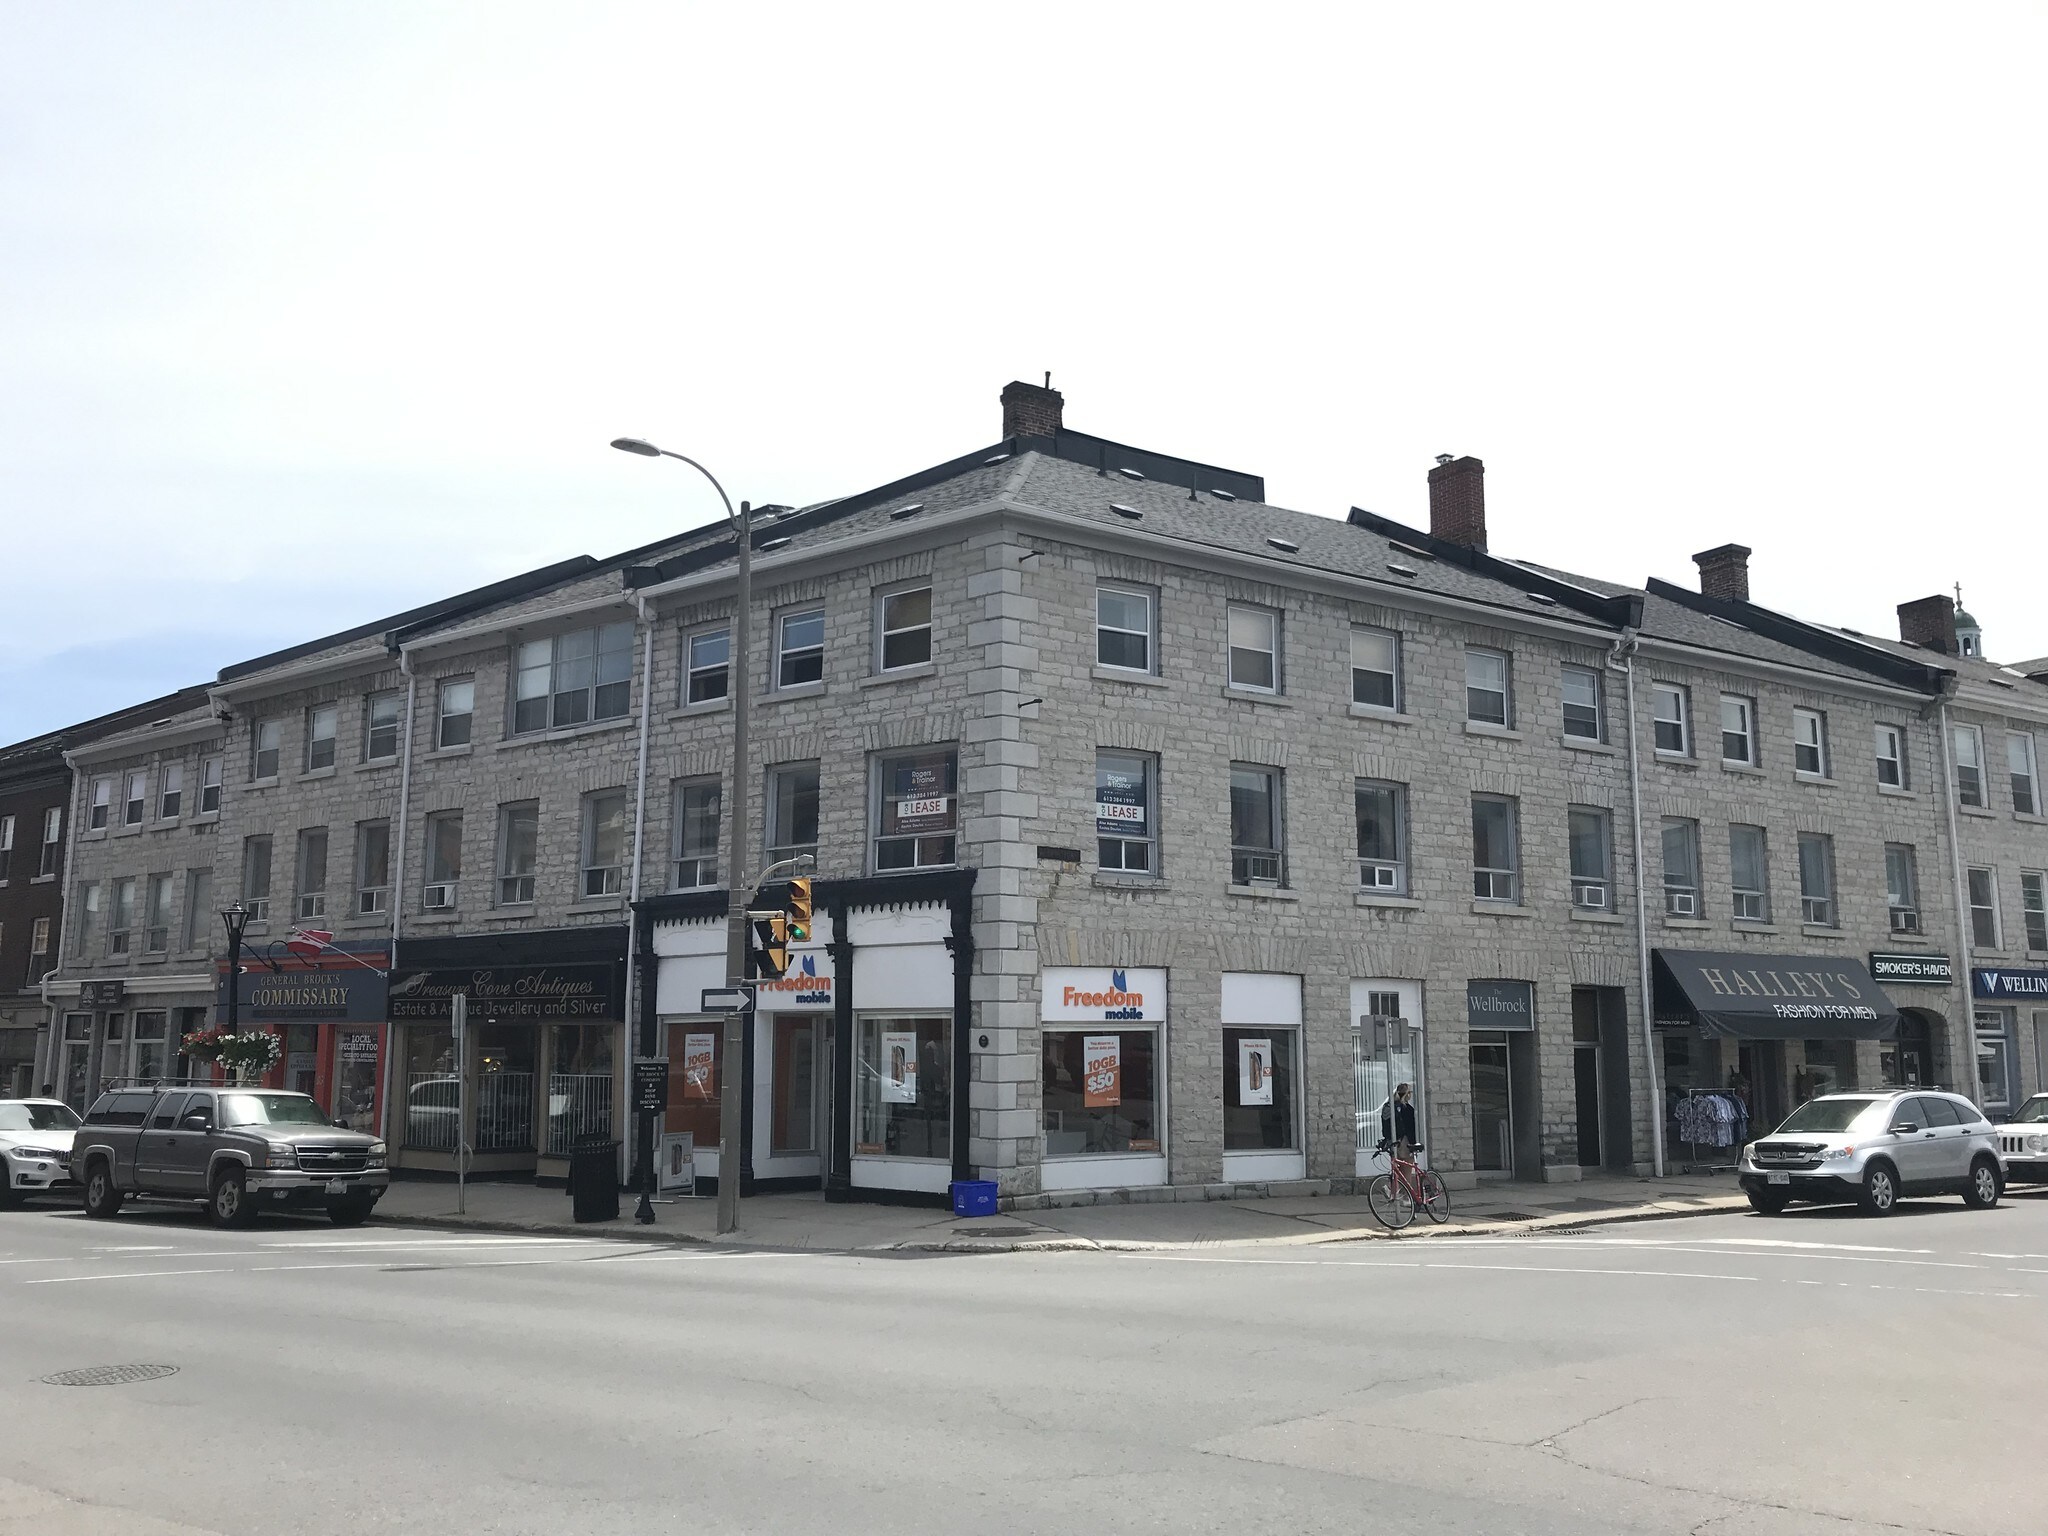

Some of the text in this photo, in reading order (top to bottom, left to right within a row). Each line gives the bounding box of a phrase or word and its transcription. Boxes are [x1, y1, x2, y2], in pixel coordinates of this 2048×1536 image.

[911, 770, 932, 779] Rogers
[1107, 774, 1127, 783] Rogers
[911, 801, 941, 813] LEASE
[1107, 806, 1138, 819] LEASE
[1875, 962, 1952, 976] SMOKER'S HAVEN
[261, 974, 340, 986] GENERAL BROCK'S
[405, 969, 593, 1003] Treasure Cove Antiques
[1699, 968, 1861, 999] HALLEY'S
[2001, 976, 2048, 993] WELLIN
[252, 987, 349, 1007] COMMISSARY
[796, 991, 831, 1004] mobile
[1063, 986, 1143, 1007] Freedom
[394, 1002, 426, 1015] Estate
[430, 1002, 437, 1015] &
[485, 1001, 540, 1017] Jewellery
[545, 1000, 566, 1014] and
[571, 1000, 606, 1014] Silver
[1470, 996, 1526, 1013] Wellbrock
[1105, 1007, 1143, 1020] mobile
[1773, 1004, 1877, 1020] FASHION FOR MEN
[351, 1035, 371, 1043] LOCAL
[366, 1043, 378, 1051] FOO
[688, 1052, 710, 1066] 10GB
[1088, 1055, 1116, 1072] 10GB
[1087, 1071, 1115, 1092] $50
